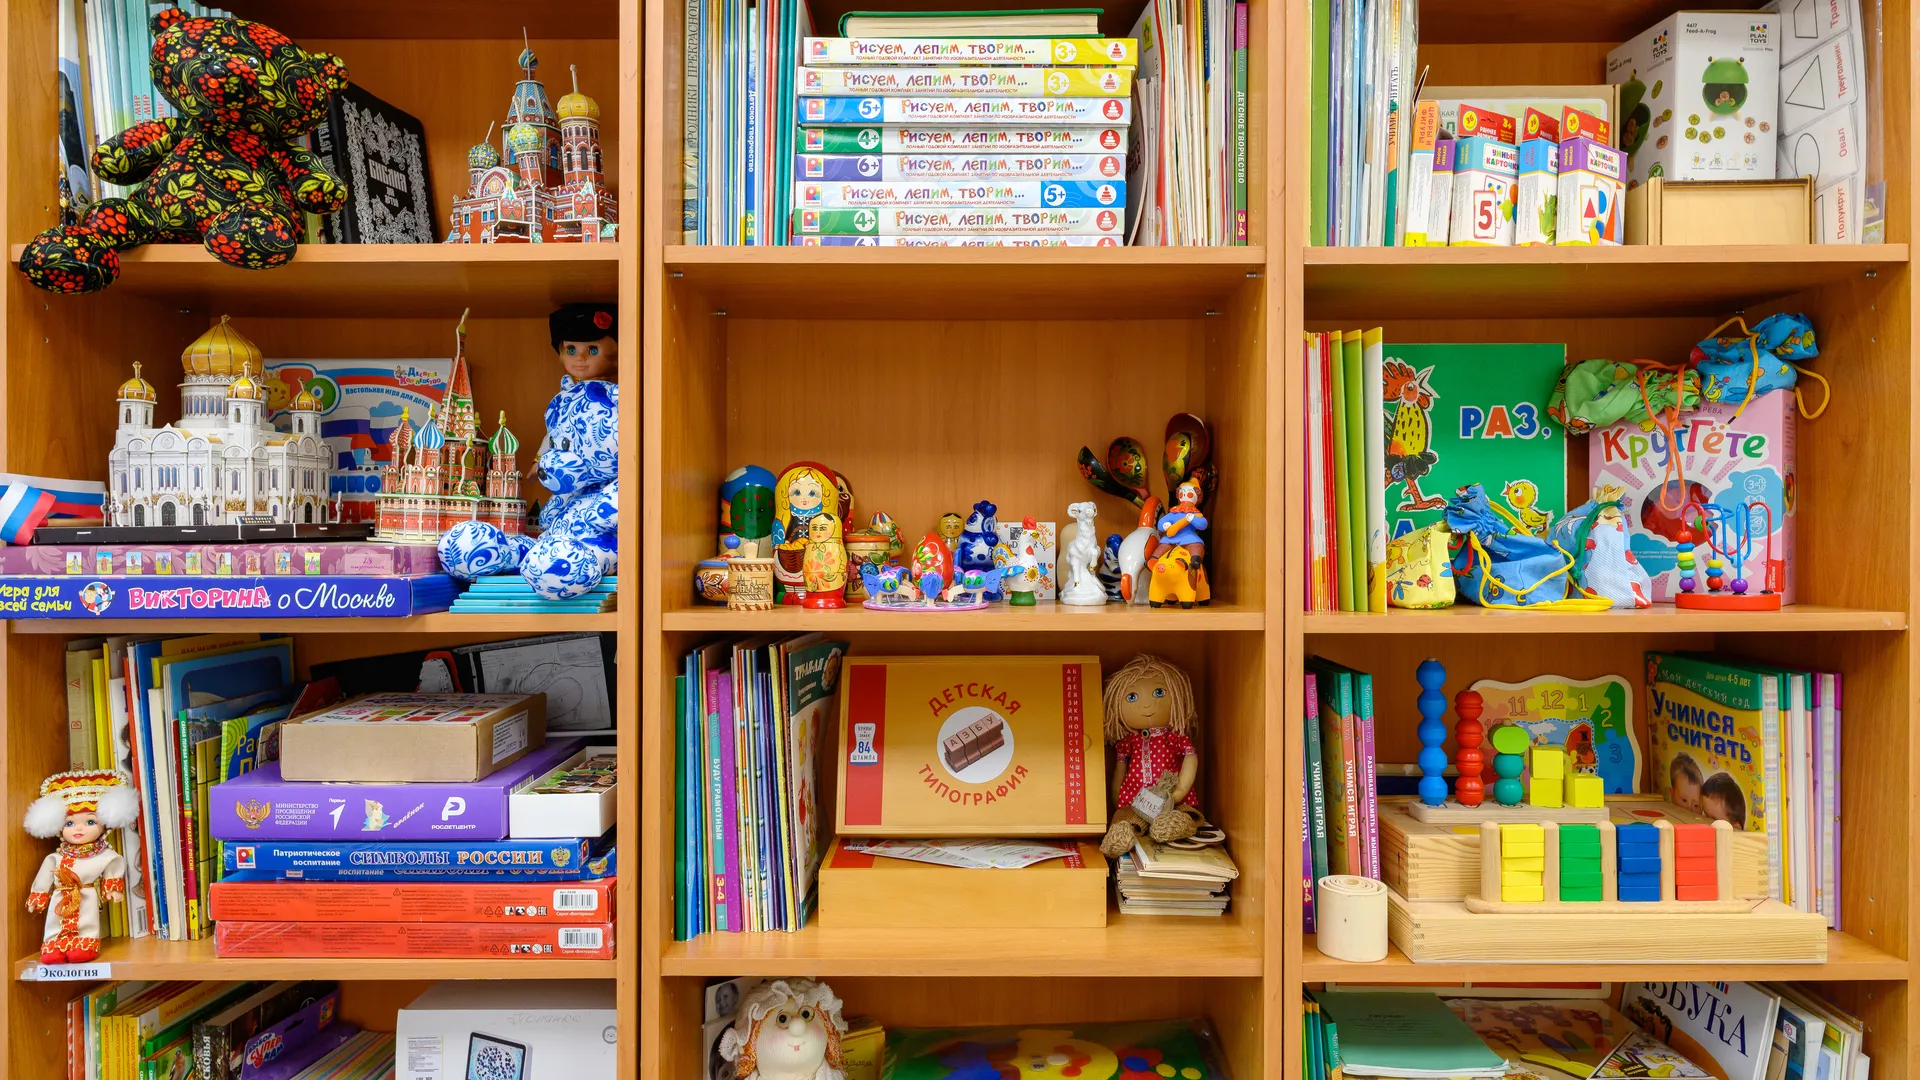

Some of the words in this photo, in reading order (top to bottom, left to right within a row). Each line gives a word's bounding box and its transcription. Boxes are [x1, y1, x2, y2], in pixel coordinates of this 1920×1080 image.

[1056, 45, 1077, 59] 3+
[1652, 42, 1668, 53] PLAN
[1653, 49, 1668, 59] TOYS
[1834, 43, 1848, 98] Треугольник
[1049, 75, 1069, 91] 3+
[748, 90, 756, 125] Детское
[861, 101, 881, 115] 5+
[1237, 91, 1245, 129] ДЕТСКОЕ
[1419, 108, 1427, 144] ФИГУРЫ
[1427, 106, 1435, 138] ЦИФРЫ
[747, 126, 755, 172] творчество
[858, 131, 879, 145] 4+
[1838, 128, 1848, 157] Овал
[858, 158, 879, 172] 6+
[1237, 130, 1245, 184] ТВОРЧЕСТВО
[1492, 149, 1517, 161] УМНЫЕ
[1590, 158, 1618, 173] КАРТОЧКИ
[1046, 188, 1066, 203] 5+
[746, 213, 755, 236] 4-5
[855, 212, 876, 228] 4+
[1478, 200, 1493, 230] 5
[1837, 187, 1845, 240] Полукруг
[1237, 213, 1246, 237] 3-4
[345, 387, 385, 395] Настольная
[384, 388, 400, 397] игра
[400, 393, 413, 401] для
[34, 585, 60, 599] для
[277, 594, 291, 609] о
[295, 582, 396, 610] Москве
[31, 600, 72, 612] семьи
[1727, 673, 1739, 685] 4-5
[1739, 677, 1751, 687] лет
[928, 682, 1021, 717] ДЕТСКАЯ
[1541, 690, 1564, 710] 12
[1578, 693, 1588, 712] 1
[1685, 679, 1727, 703] детский
[1732, 697, 1751, 709] сад
[1508, 696, 1528, 716] 11
[1651, 688, 1735, 737] Учимся
[1600, 709, 1613, 728] 2
[858, 741, 871, 753] 84
[1608, 743, 1622, 764] 3
[1667, 722, 1752, 763] считать
[712, 758, 720, 781] БУДУ
[1345, 759, 1355, 801] УЧИМСЯ
[918, 763, 1029, 806] ТИПОГРАФИЯ
[1312, 761, 1323, 804] УЧИМСЯ
[714, 783, 722, 840] ГРАМОТНЫМ
[1315, 806, 1324, 838] ИГРАЯ
[1348, 803, 1357, 838] ИГРАЯ
[273, 849, 341, 858] Патриотическое
[293, 859, 341, 867] воспитание
[350, 851, 450, 866] СИМВОЛЫ
[457, 850, 543, 865] РОССИИ
[715, 877, 725, 901] 3-4
[40, 967, 98, 978] Экология
